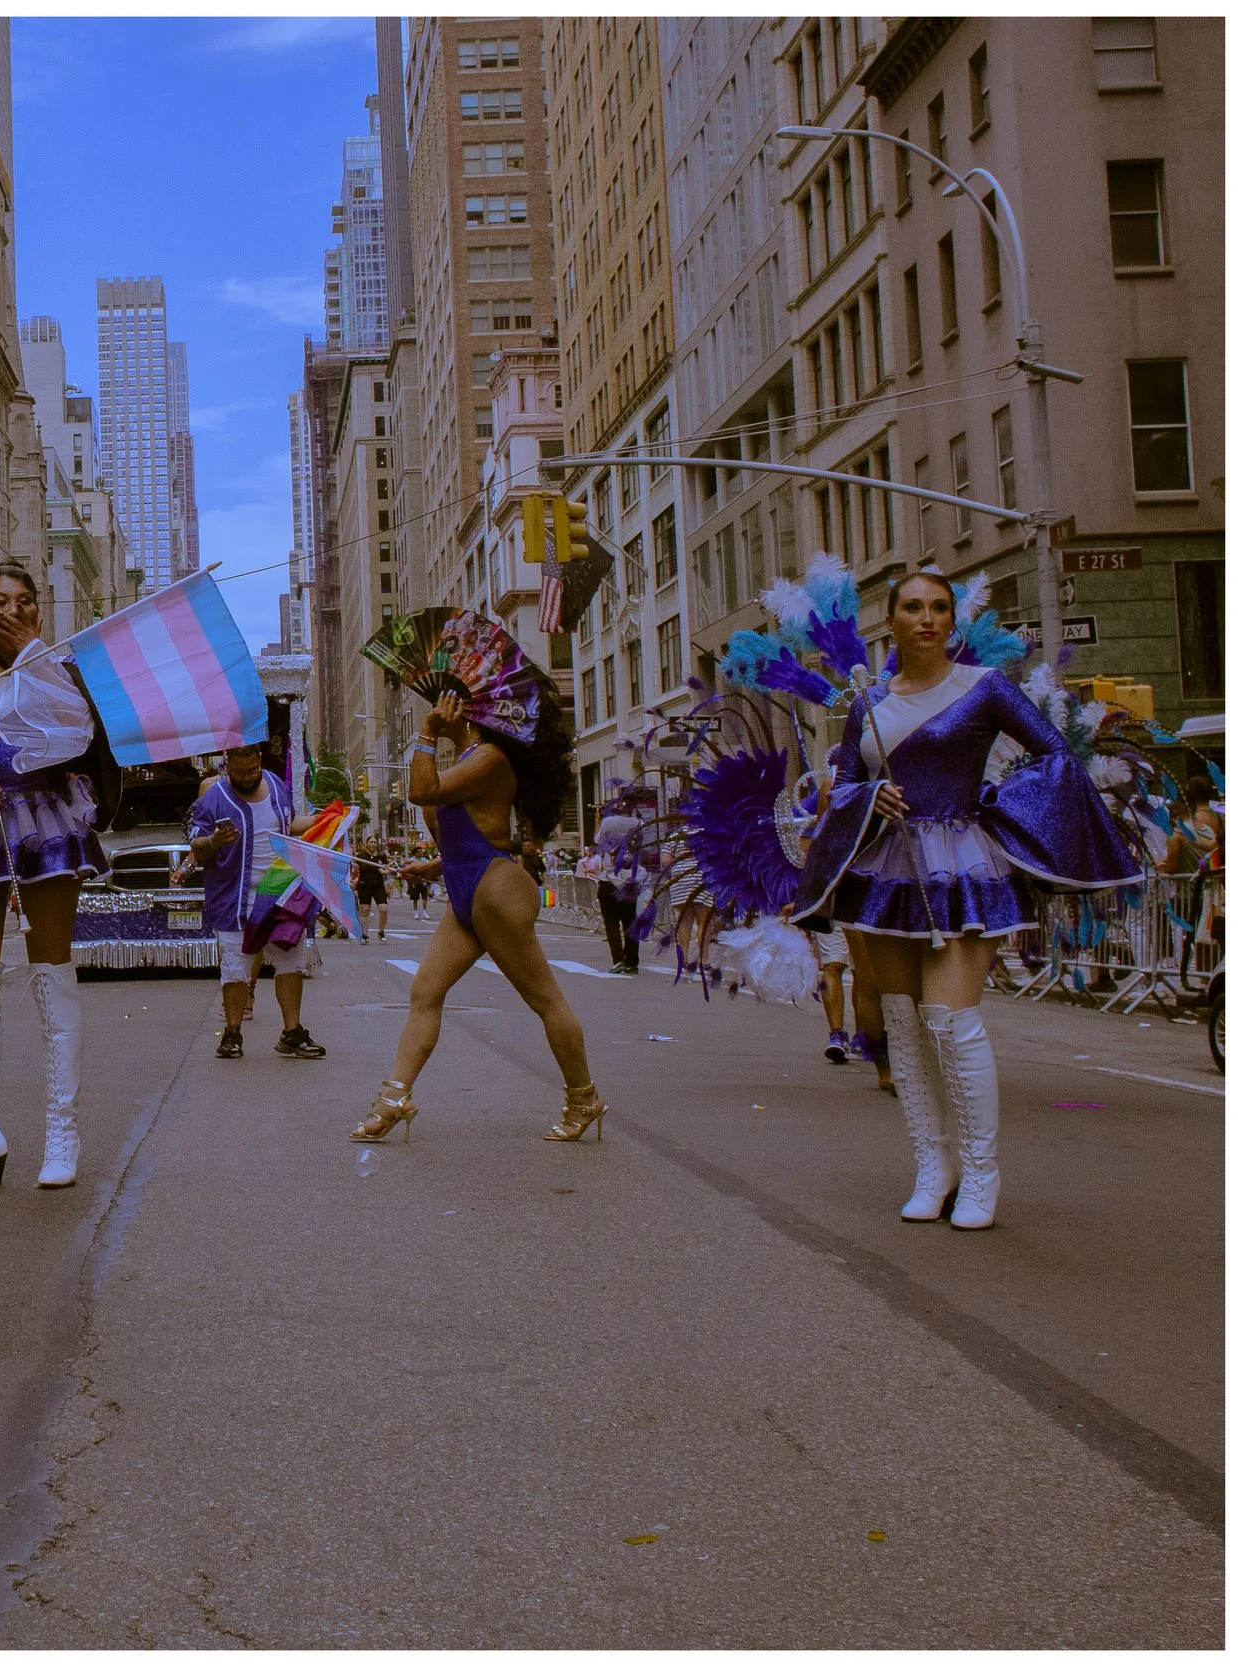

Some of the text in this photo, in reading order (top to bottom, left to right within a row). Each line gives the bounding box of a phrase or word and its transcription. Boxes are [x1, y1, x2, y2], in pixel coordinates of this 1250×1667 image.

[1078, 553, 1126, 570] E 27 St
[1062, 625, 1084, 640] AY
